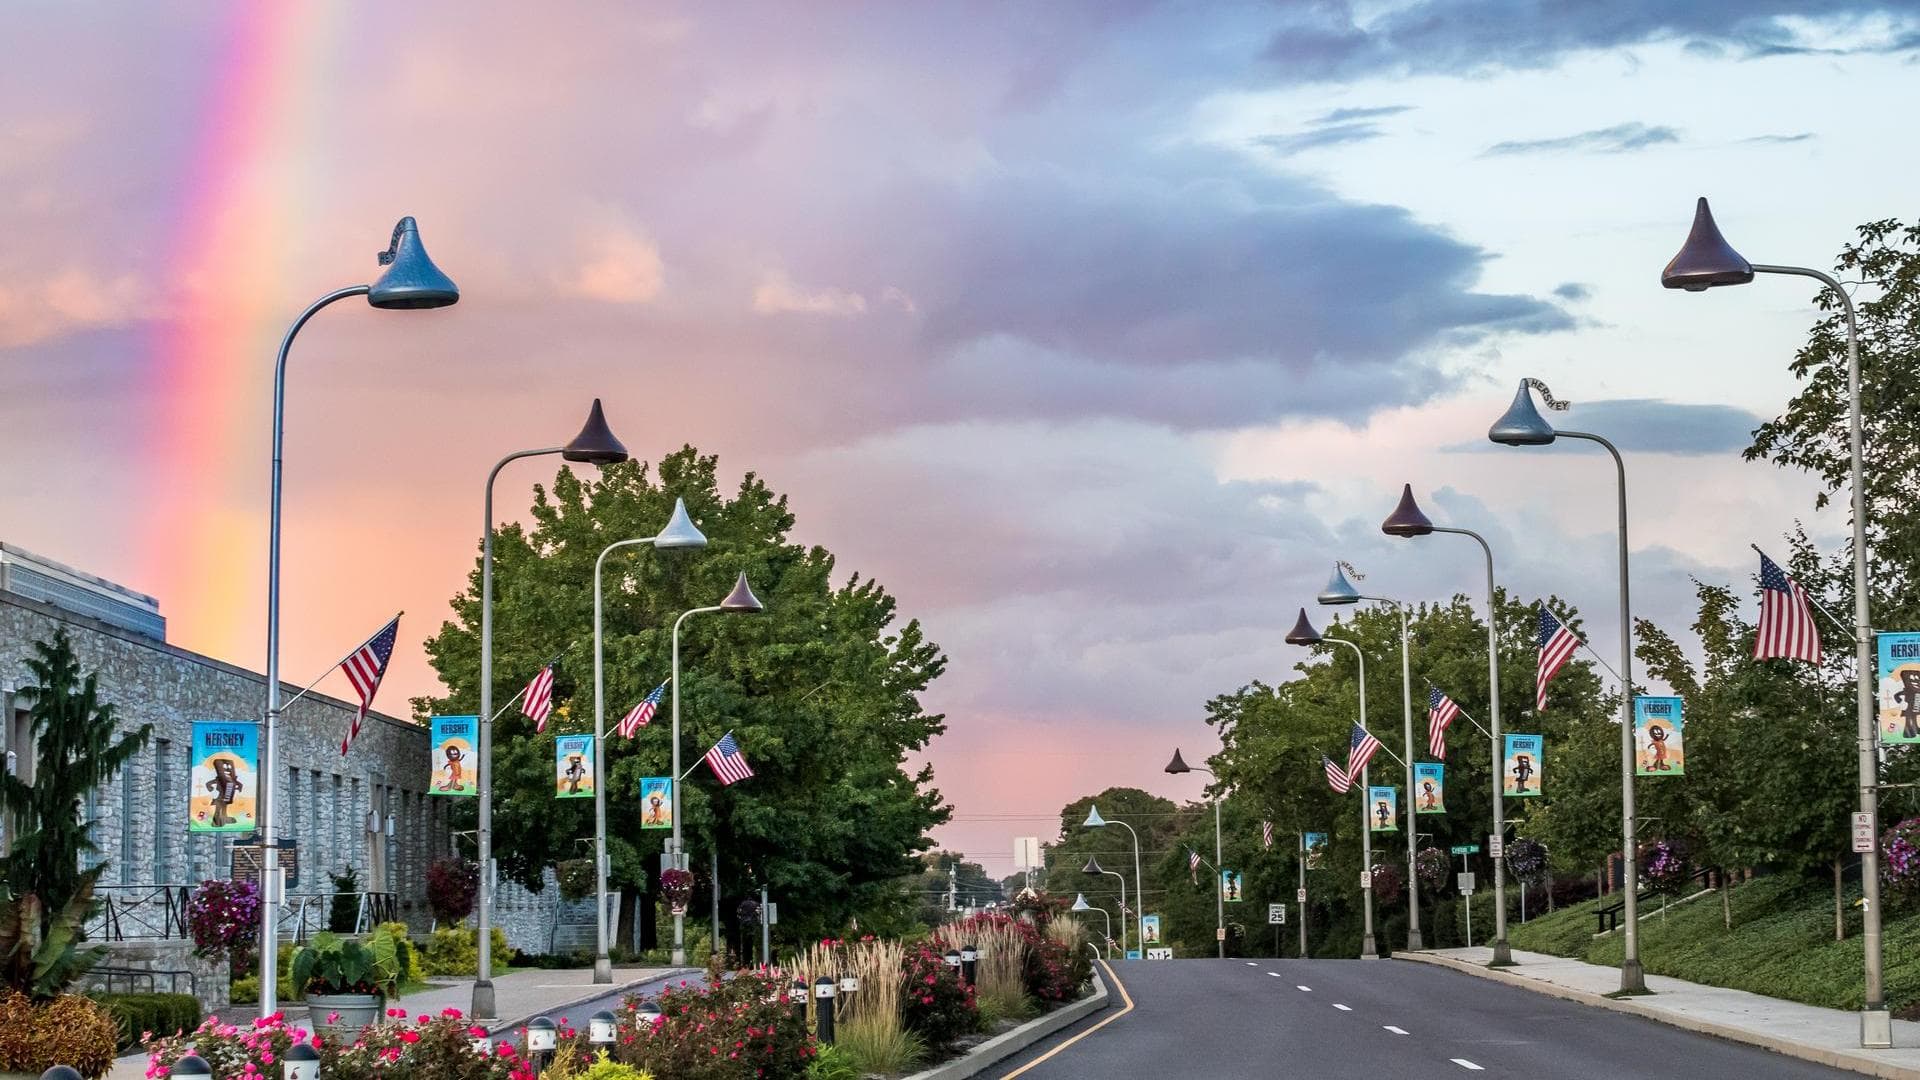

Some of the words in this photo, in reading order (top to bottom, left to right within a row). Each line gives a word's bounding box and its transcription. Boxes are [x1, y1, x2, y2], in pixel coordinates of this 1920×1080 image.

[1531, 378, 1569, 410] HERSHEY
[1341, 561, 1366, 580] HERSHEY
[1644, 704, 1672, 714] HERSHEY
[441, 724, 469, 734] HERSHEY
[206, 733, 245, 747] HERSHEY
[1271, 914, 1284, 922] 25
